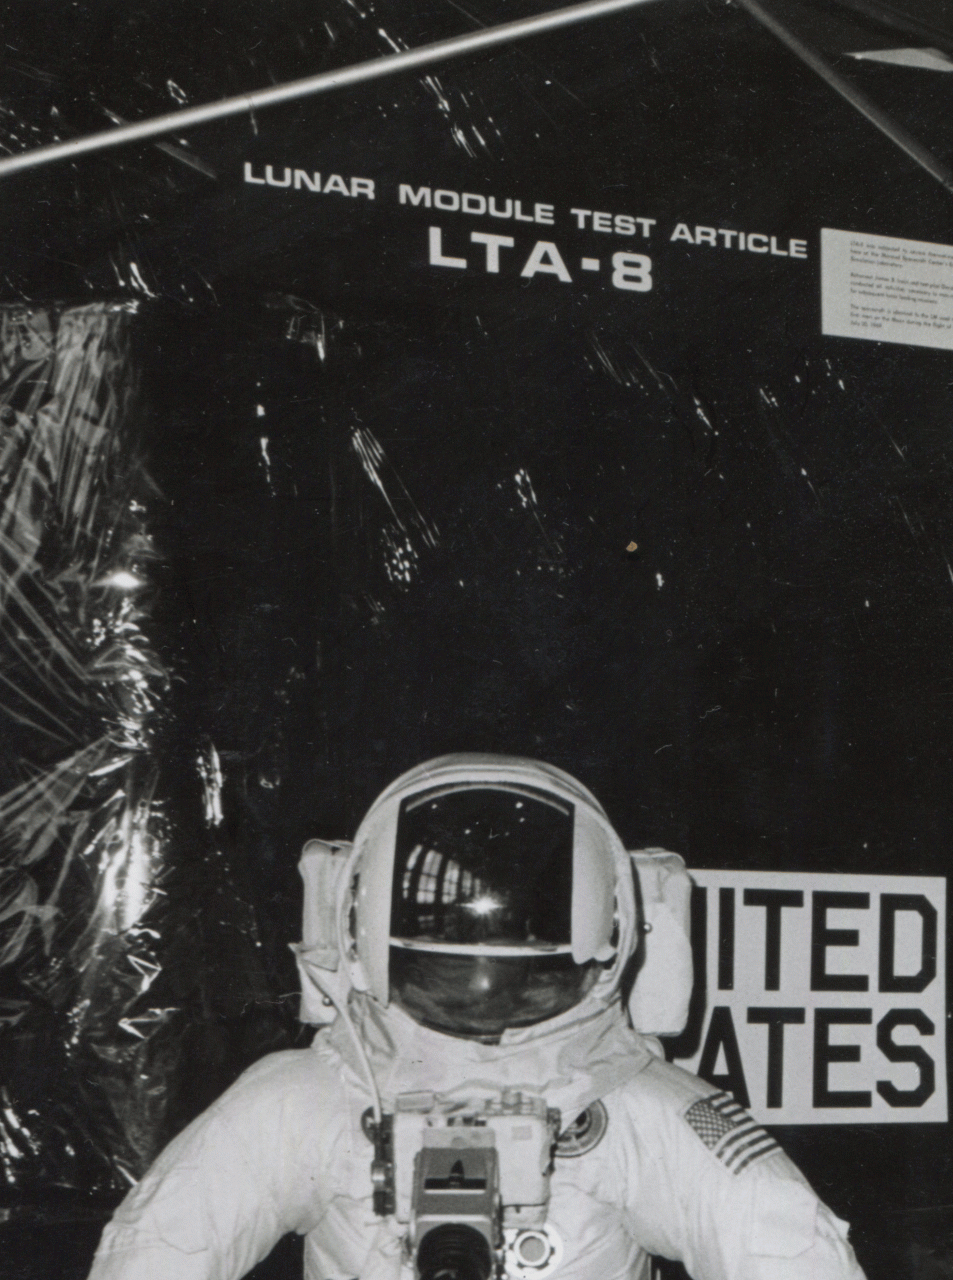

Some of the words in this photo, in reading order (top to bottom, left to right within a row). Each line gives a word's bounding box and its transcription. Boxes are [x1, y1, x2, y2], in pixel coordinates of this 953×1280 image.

[243, 161, 376, 200] LUNAR
[398, 183, 555, 225] MODULE
[570, 208, 657, 238] TEST
[670, 223, 808, 259] ARTICLE
[428, 226, 653, 293] LTA-8
[694, 886, 938, 993] ITED
[697, 1006, 936, 1109] ATES
